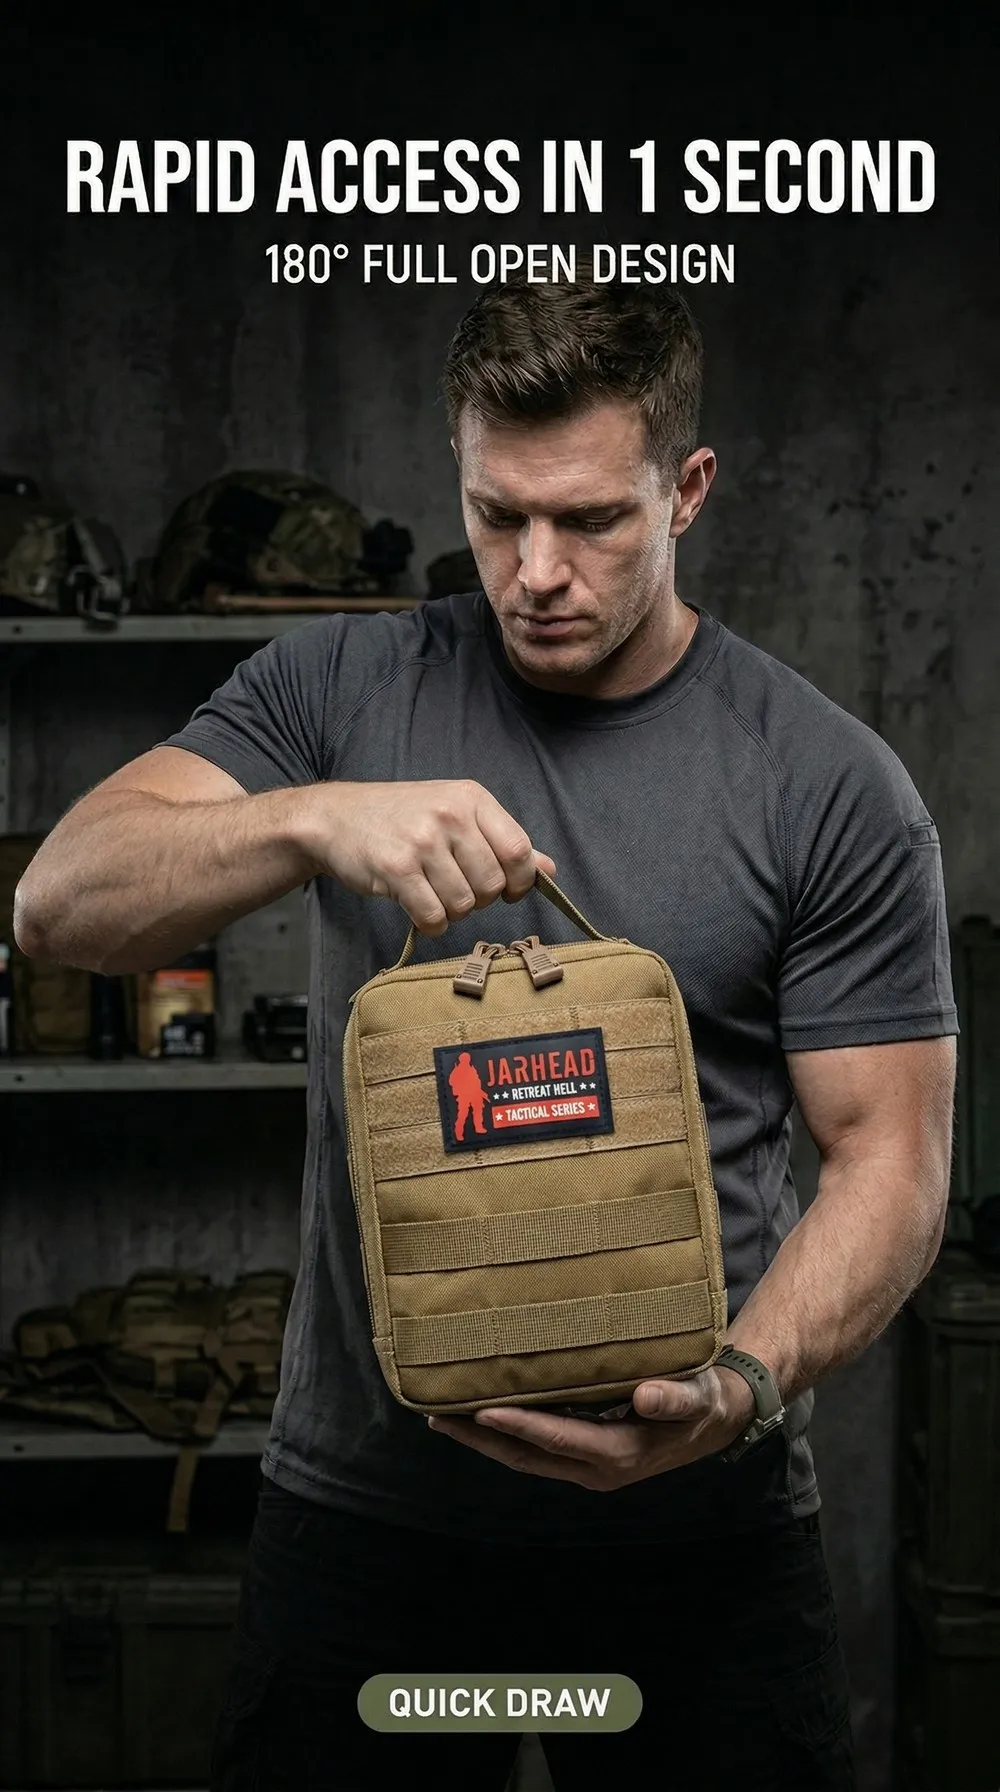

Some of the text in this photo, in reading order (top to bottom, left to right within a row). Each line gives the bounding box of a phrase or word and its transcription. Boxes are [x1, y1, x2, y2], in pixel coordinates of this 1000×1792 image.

[487, 1048, 596, 1087] JARHEAD
[511, 1082, 577, 1101] RETREAT HELL
[505, 1101, 586, 1122] TACTICAL SERIES
